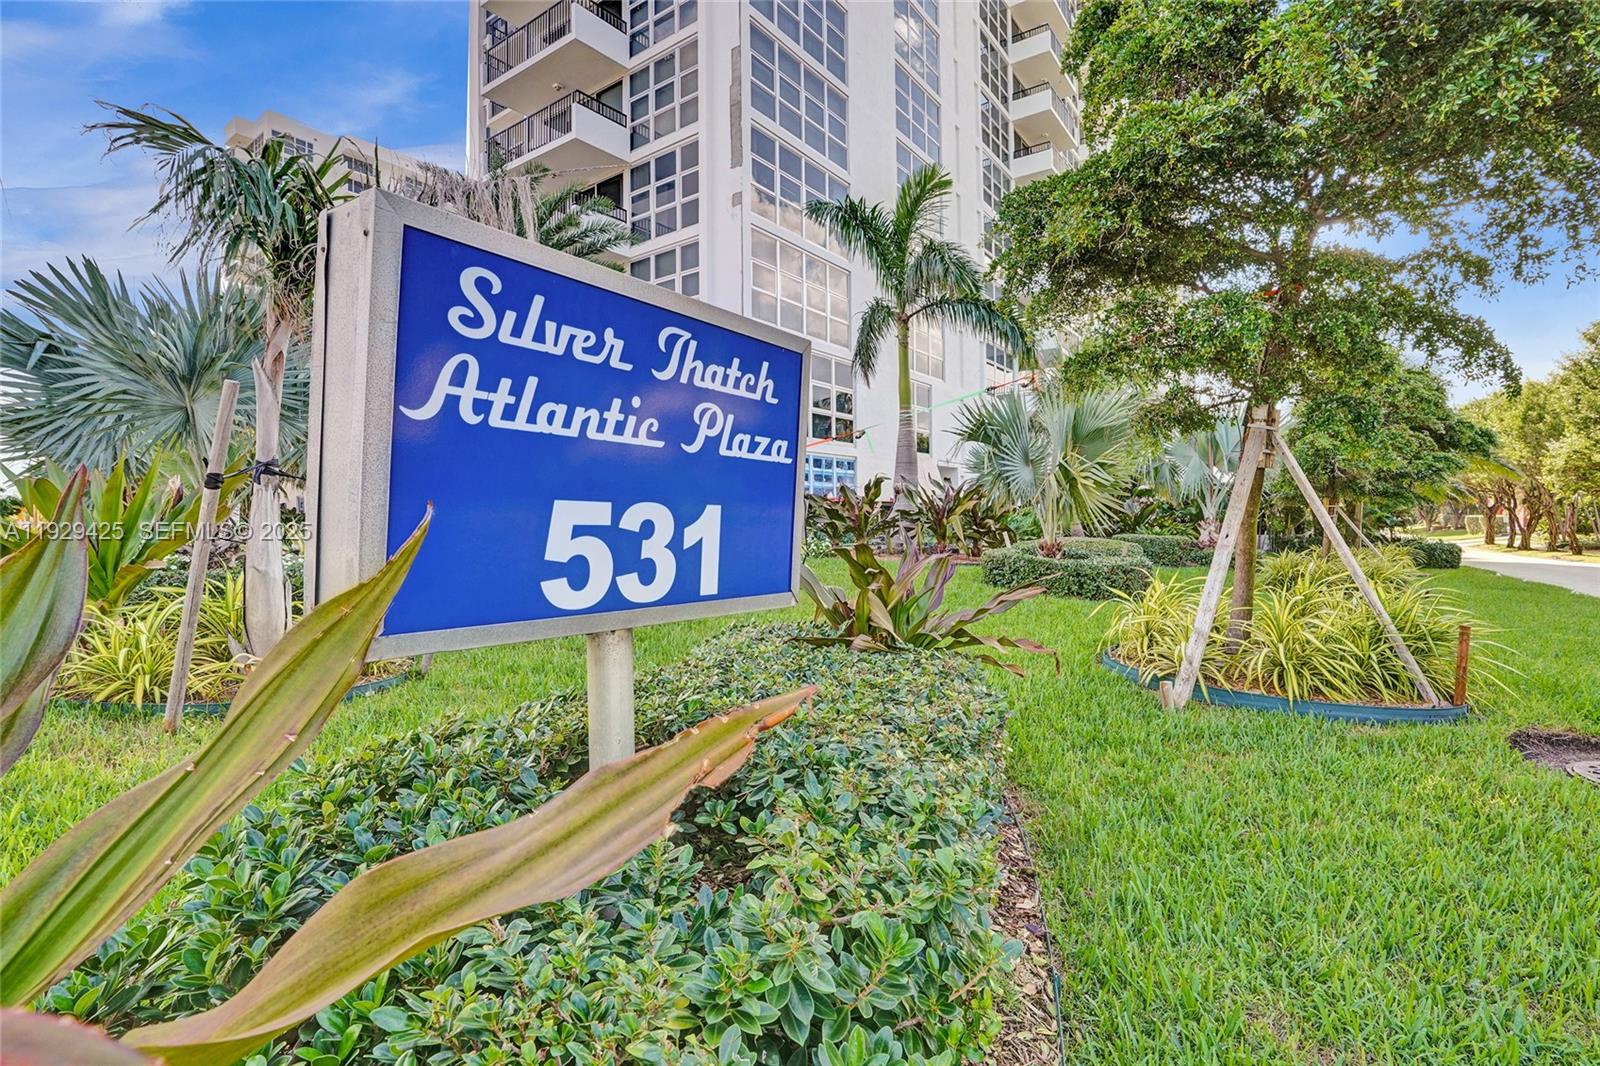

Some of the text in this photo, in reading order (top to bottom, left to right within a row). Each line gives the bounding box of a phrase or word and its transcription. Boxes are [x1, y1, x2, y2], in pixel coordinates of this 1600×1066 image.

[447, 267, 779, 404] Silver Thatch
[400, 353, 793, 464] Atlantic Plaza
[540, 499, 722, 610] 531
